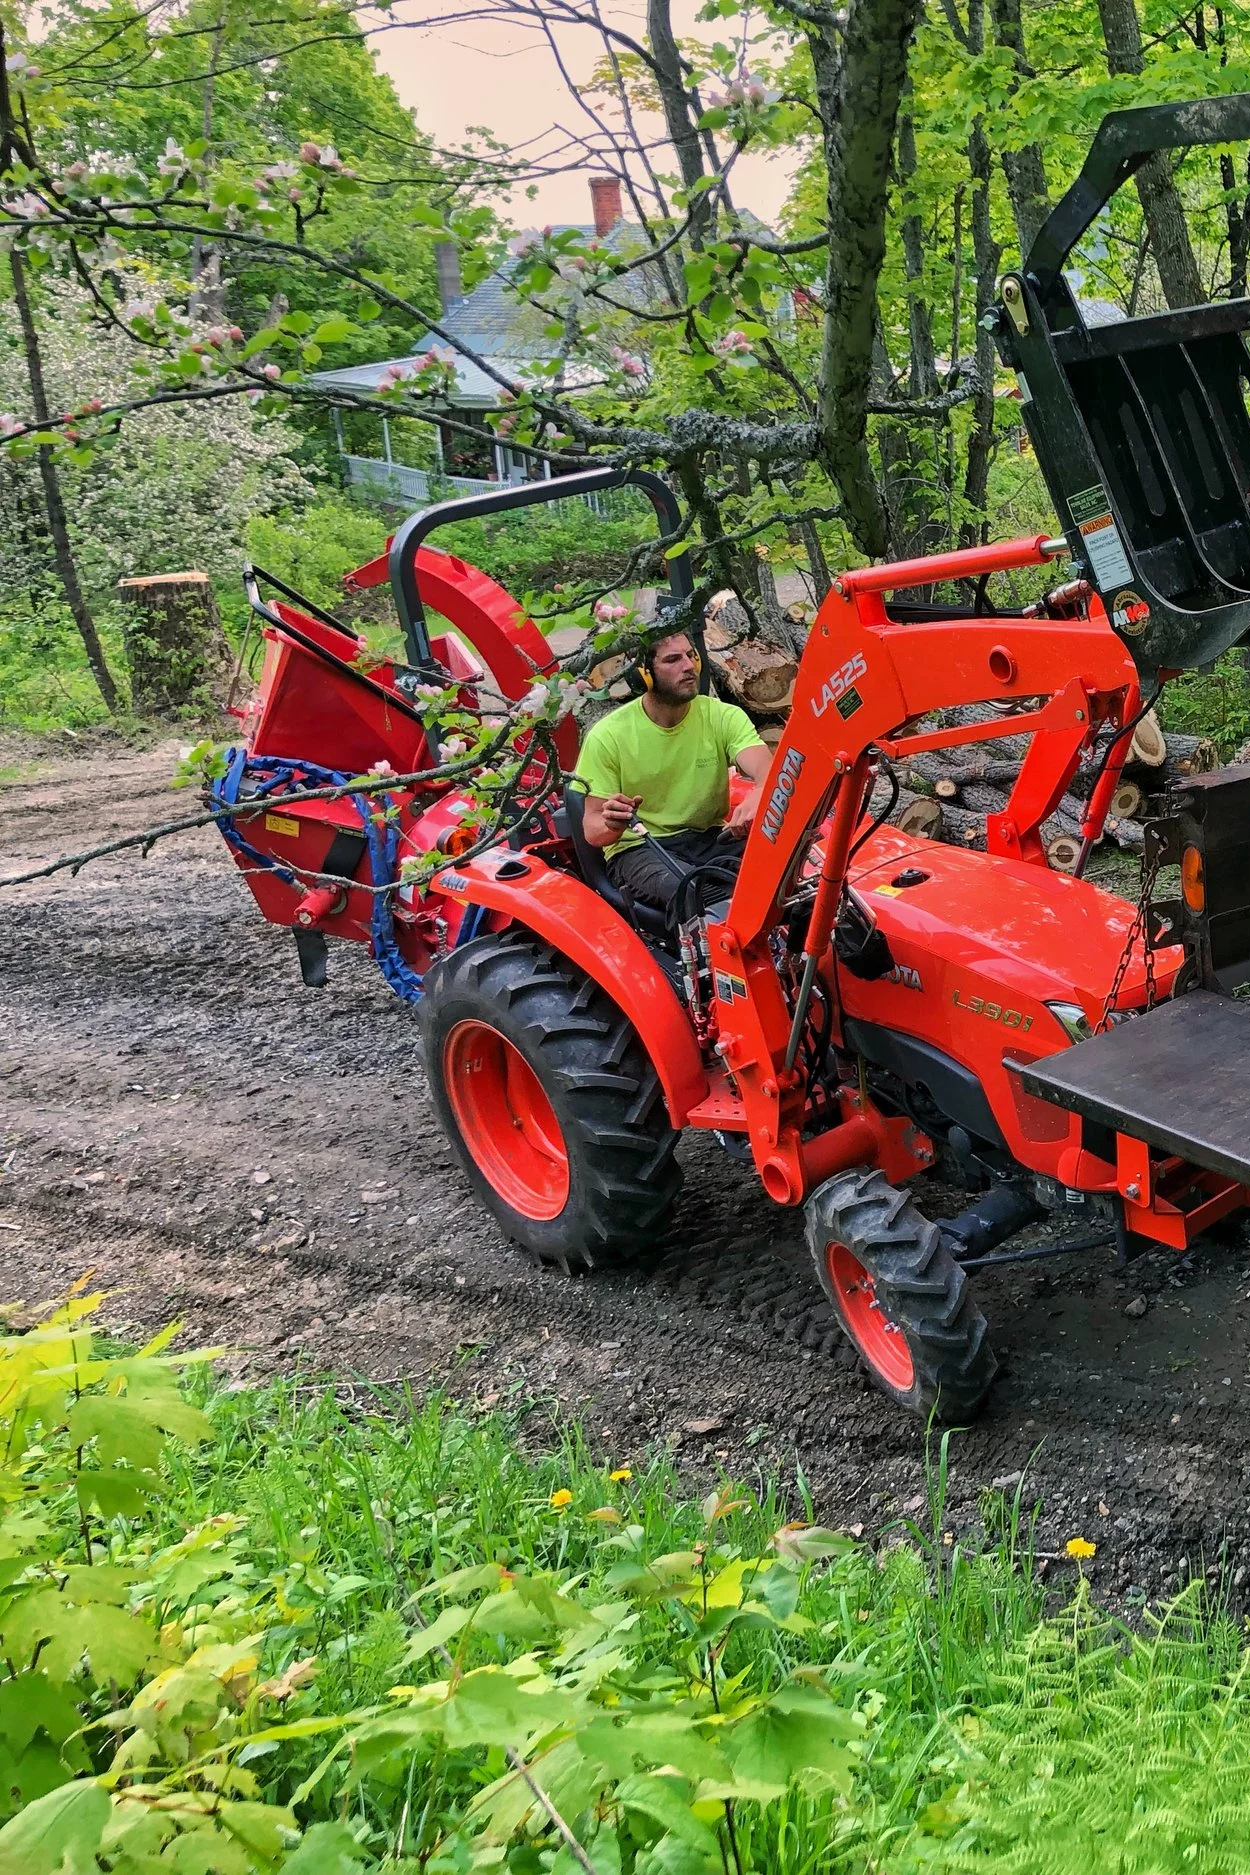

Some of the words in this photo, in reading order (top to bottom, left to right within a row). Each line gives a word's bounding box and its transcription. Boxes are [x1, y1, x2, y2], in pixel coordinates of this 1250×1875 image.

[1085, 514, 1114, 533] WARNING
[810, 651, 867, 718] LA525
[761, 746, 806, 844] KUBOTA
[880, 963, 924, 992] OTA
[952, 990, 1034, 1032] L3901
